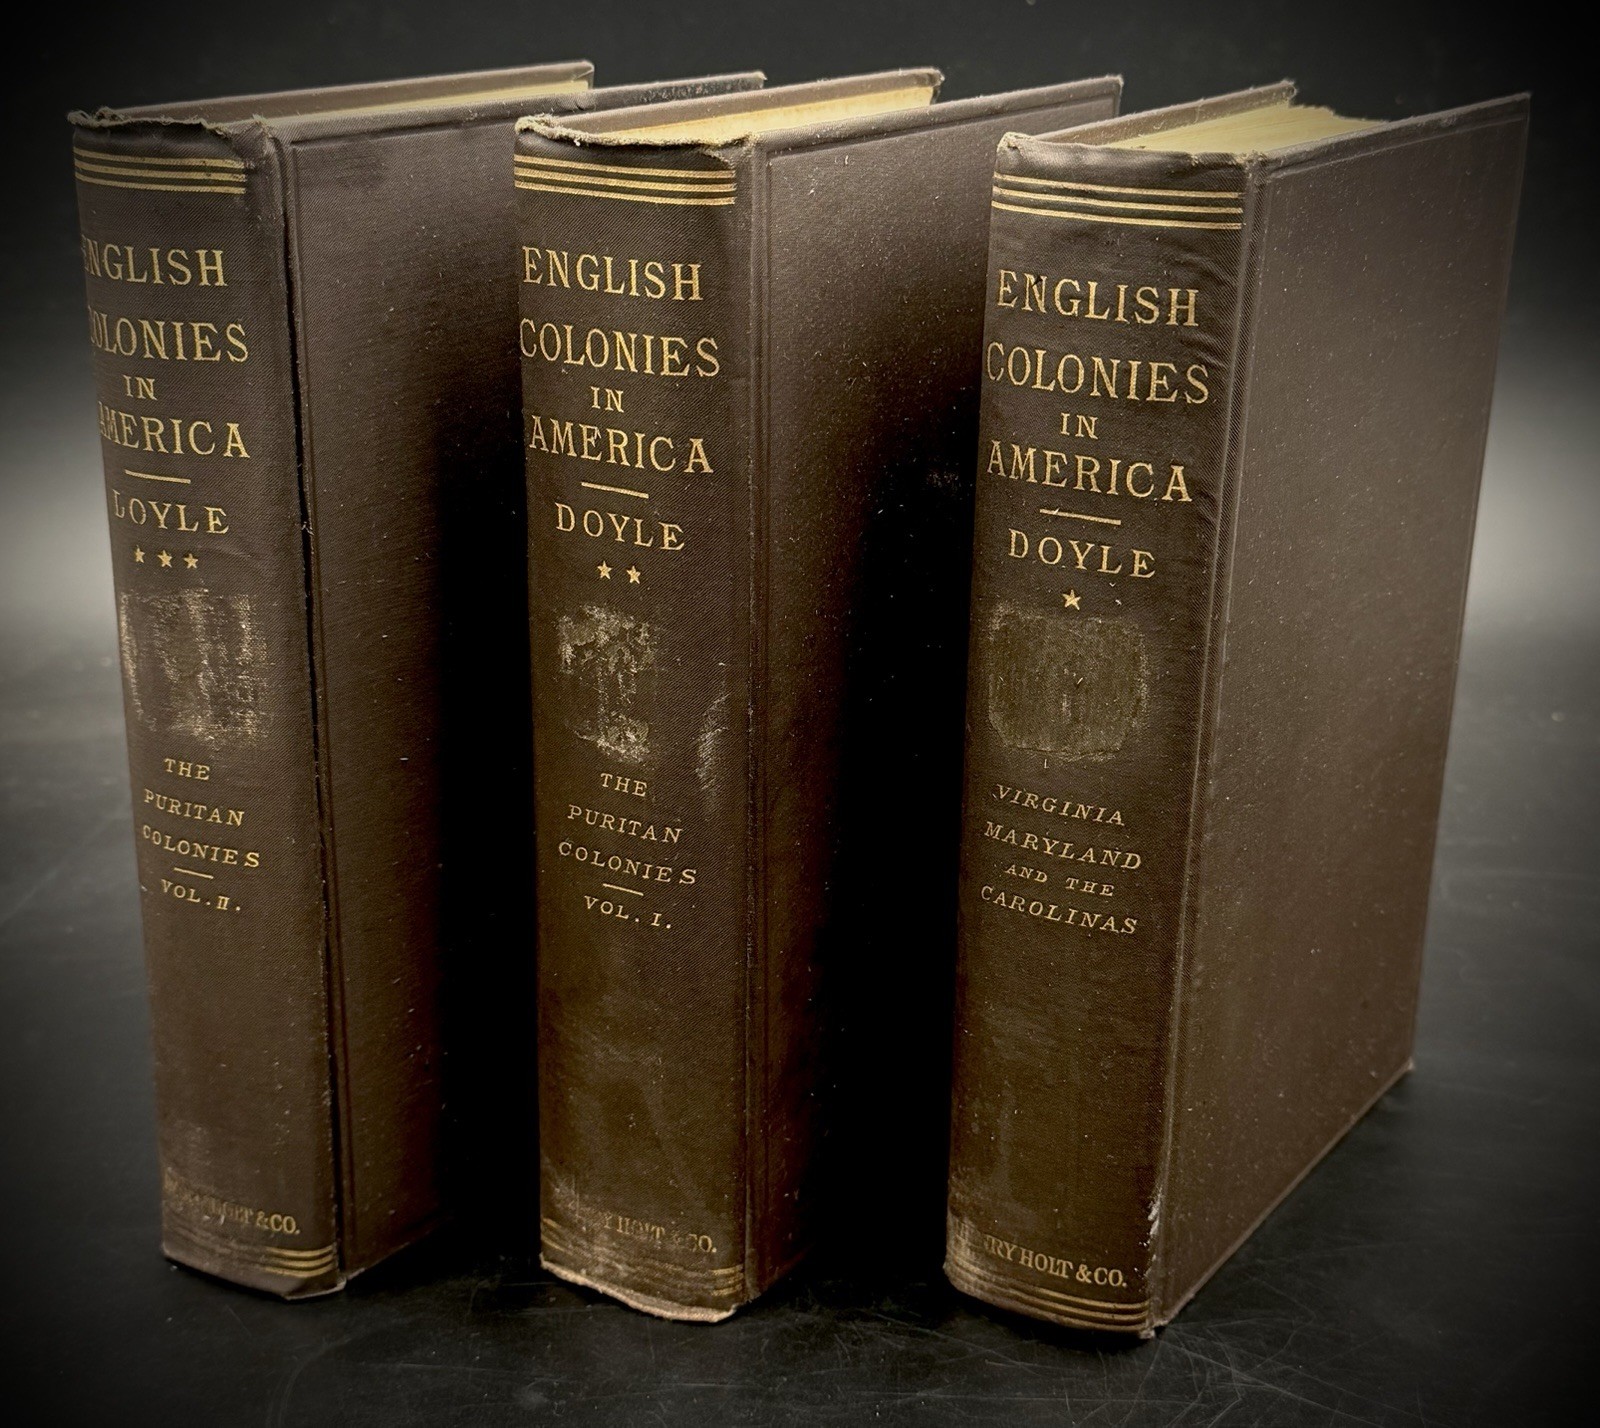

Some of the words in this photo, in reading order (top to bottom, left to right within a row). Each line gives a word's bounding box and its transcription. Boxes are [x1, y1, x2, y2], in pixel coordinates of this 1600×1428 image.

[522, 246, 704, 301] ENGLISH
[997, 269, 1199, 327] ENGLISH
[519, 318, 720, 377] COLONIES
[123, 374, 157, 400] IN
[986, 342, 1210, 404] COLONIES
[591, 386, 624, 413] IN
[528, 415, 714, 474] AMERICA
[1060, 412, 1098, 440] IN
[986, 440, 1193, 502] AMERICA
[555, 502, 685, 551] DOYLE
[1007, 528, 1156, 579] DOYLE
[164, 757, 210, 781] THE
[600, 772, 648, 797] THE
[144, 788, 245, 827] PURITAN
[567, 804, 683, 844] PURITAN
[996, 784, 1125, 826] VIRGINIA
[142, 825, 261, 868] COLONIES
[558, 841, 698, 885] COLONIES
[984, 821, 1142, 870] MARYLAND
[1005, 864, 1048, 883] AND
[1066, 878, 1115, 897] THE
[584, 895, 641, 923] VOL.
[651, 912, 672, 929] I.
[981, 885, 1138, 934] CAROLINAS
[1019, 1247, 1073, 1279] HOLT
